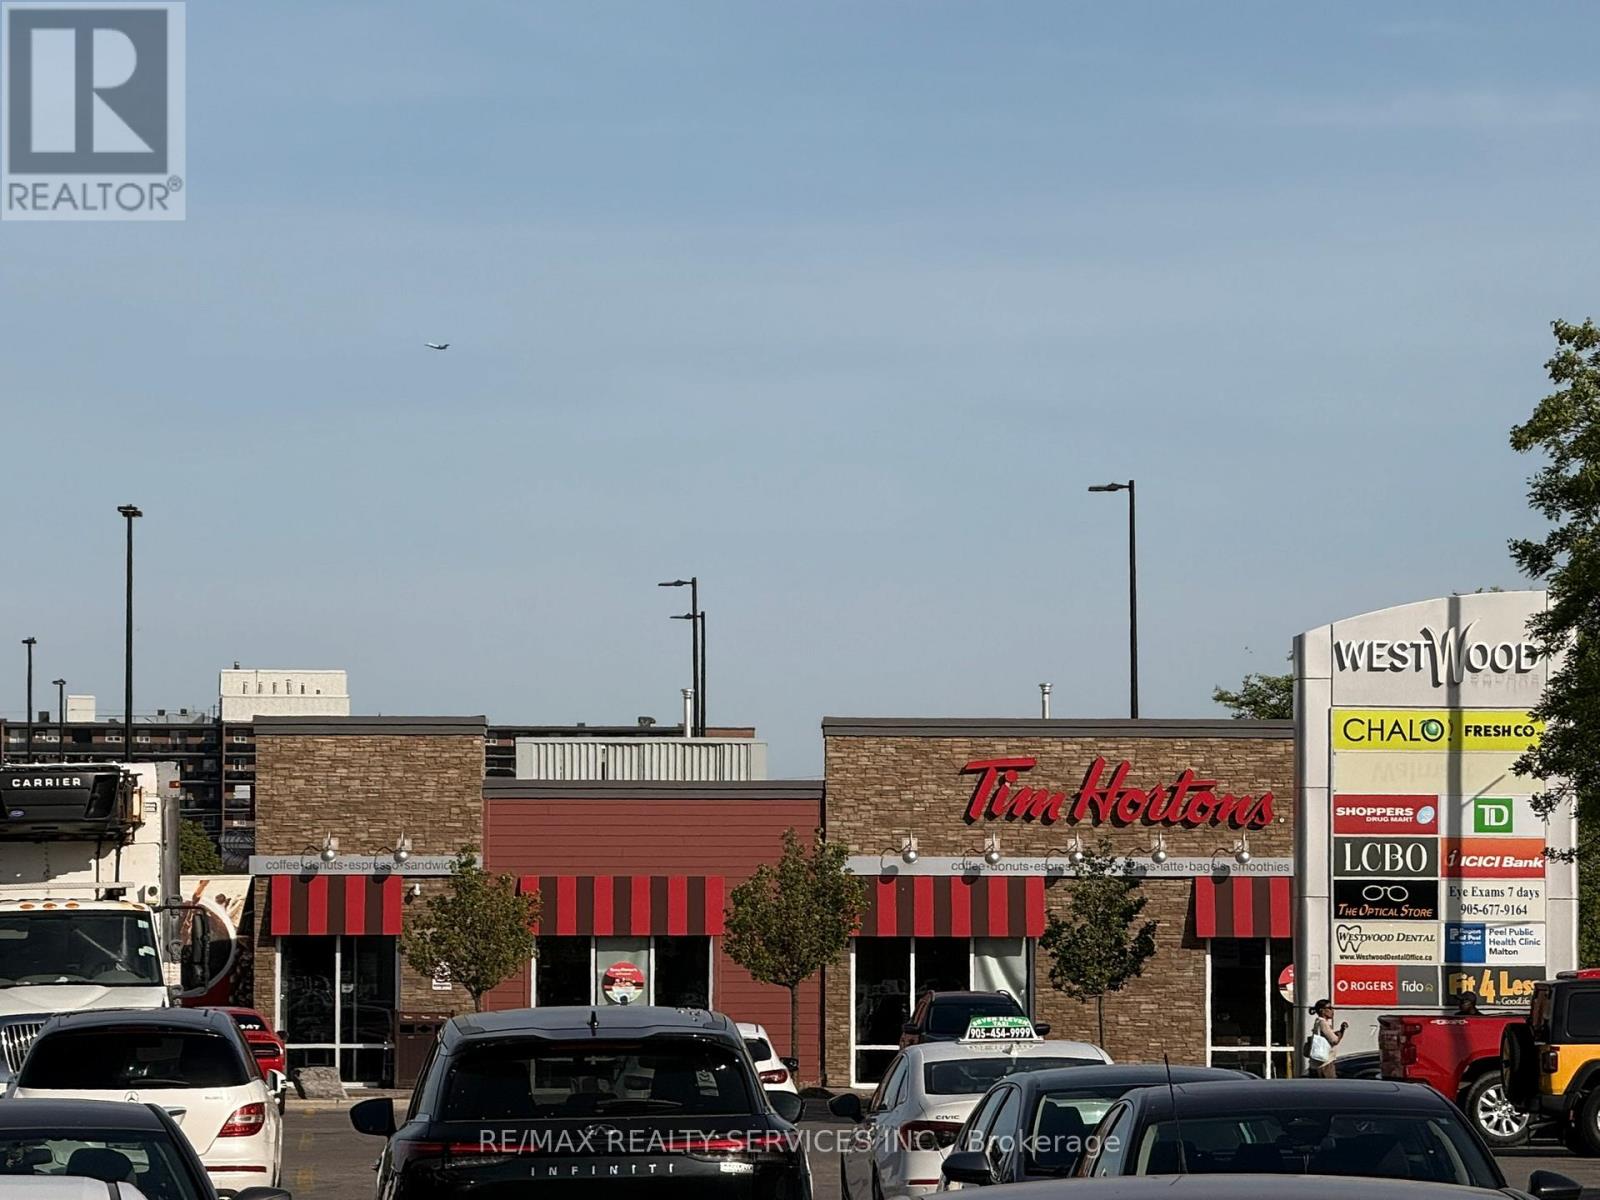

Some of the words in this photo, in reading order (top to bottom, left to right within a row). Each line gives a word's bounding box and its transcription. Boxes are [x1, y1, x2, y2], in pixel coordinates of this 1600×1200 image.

[1334, 618, 1543, 687] WESTWOOD
[11, 777, 81, 788] CARRIER
[962, 757, 1066, 824] Tim
[1070, 755, 1274, 828] Hortons
[1336, 807, 1414, 816] SHOPPERS
[1477, 804, 1509, 826] TD
[1344, 842, 1428, 872] LCBO
[1460, 855, 1500, 867] ICICI
[1502, 855, 1543, 868] Bank
[265, 859, 299, 870] coffee
[305, 859, 344, 870] donuts
[951, 860, 985, 871] coffee
[1232, 861, 1289, 871] smoothies
[1449, 885, 1468, 900] Eye
[1472, 886, 1505, 897] Exams
[1508, 886, 1514, 897] 7
[1517, 886, 1540, 900] days
[1338, 904, 1357, 916] THE
[1359, 904, 1398, 916] OPTICAL
[1400, 904, 1433, 917] STORE
[1460, 904, 1527, 915] 905-677-9164
[1396, 932, 1436, 942] DENTAL
[1488, 928, 1506, 936] Peel
[1508, 928, 1534, 936] Public
[1488, 938, 1516, 946] Health
[1518, 938, 1541, 946] Clinic
[1350, 981, 1394, 991] ROGERS
[1402, 980, 1424, 992] fido
[1448, 972, 1476, 995] Fit
[1479, 968, 1496, 1003] 4
[970, 1027, 1031, 1038] 905-454-9999
[531, 1163, 674, 1177] INFINITI
